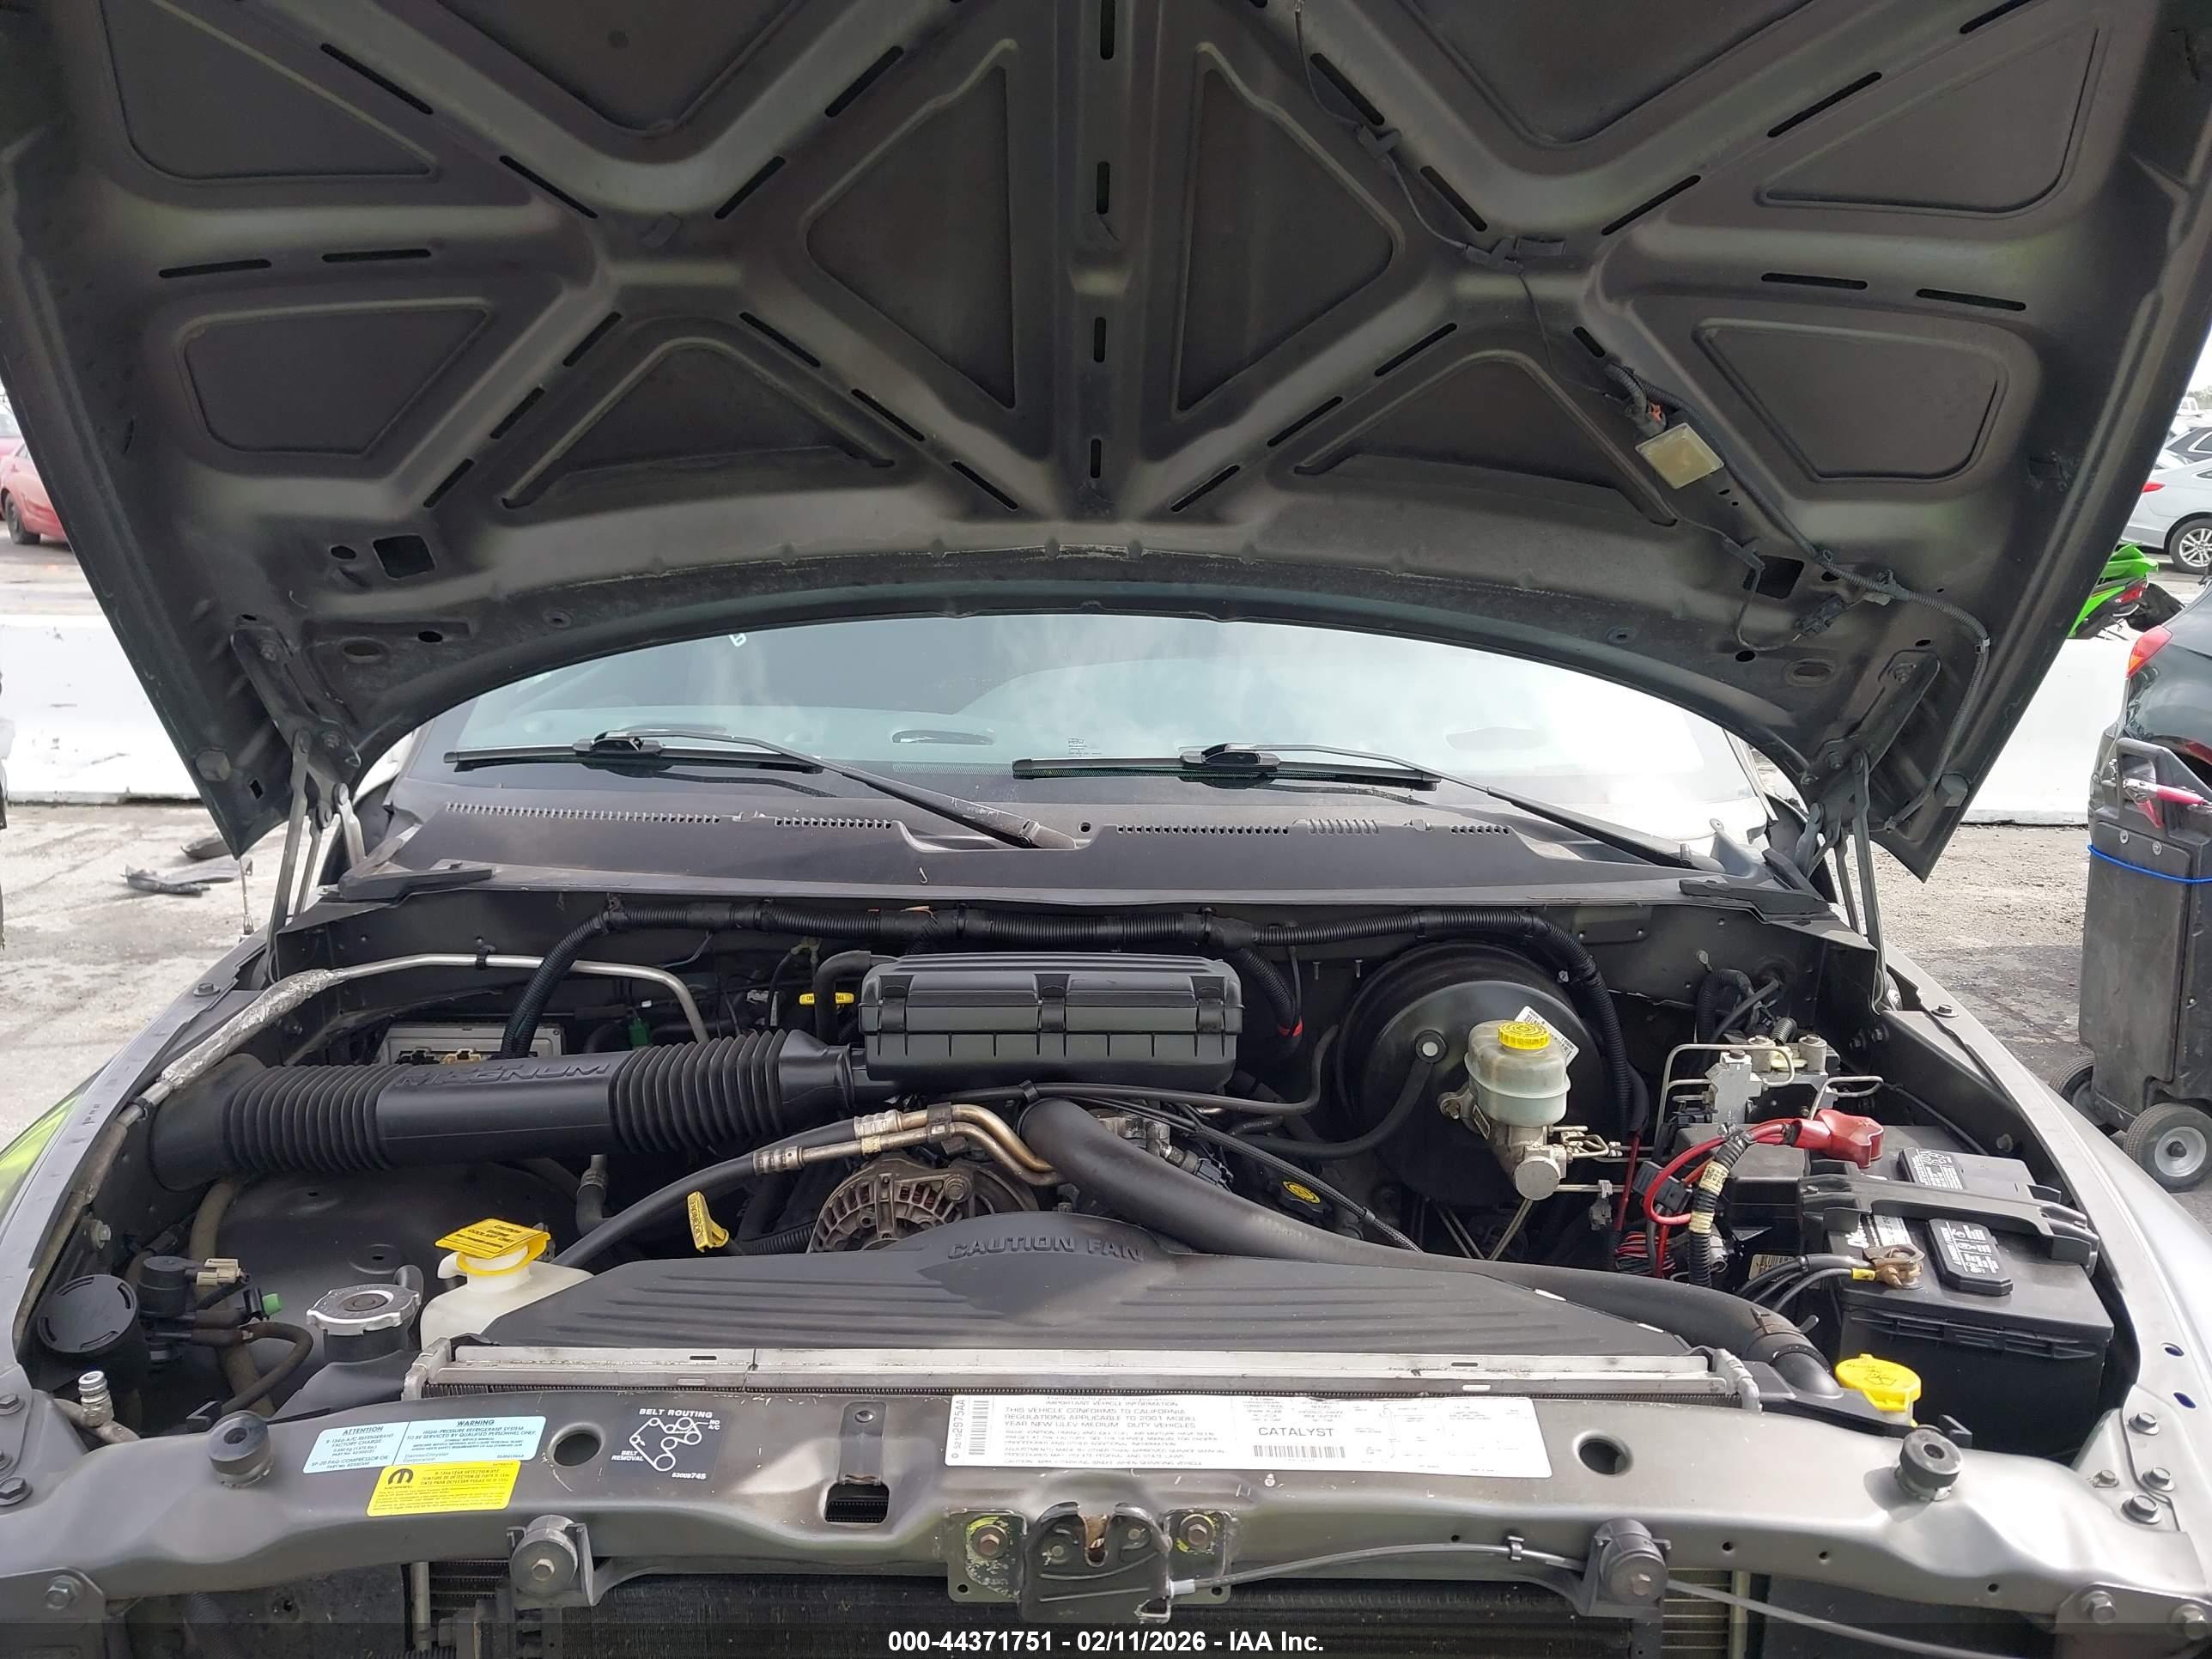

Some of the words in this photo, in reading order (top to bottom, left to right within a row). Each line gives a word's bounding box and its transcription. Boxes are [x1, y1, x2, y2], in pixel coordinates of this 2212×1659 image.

[948, 1236, 1075, 1259] CAUTION
[1085, 1239, 1144, 1263] FAN
[667, 1409, 713, 1419] ROUTING
[343, 1426, 384, 1436] ATTENTION
[1259, 1427, 1334, 1437] CATALYST
